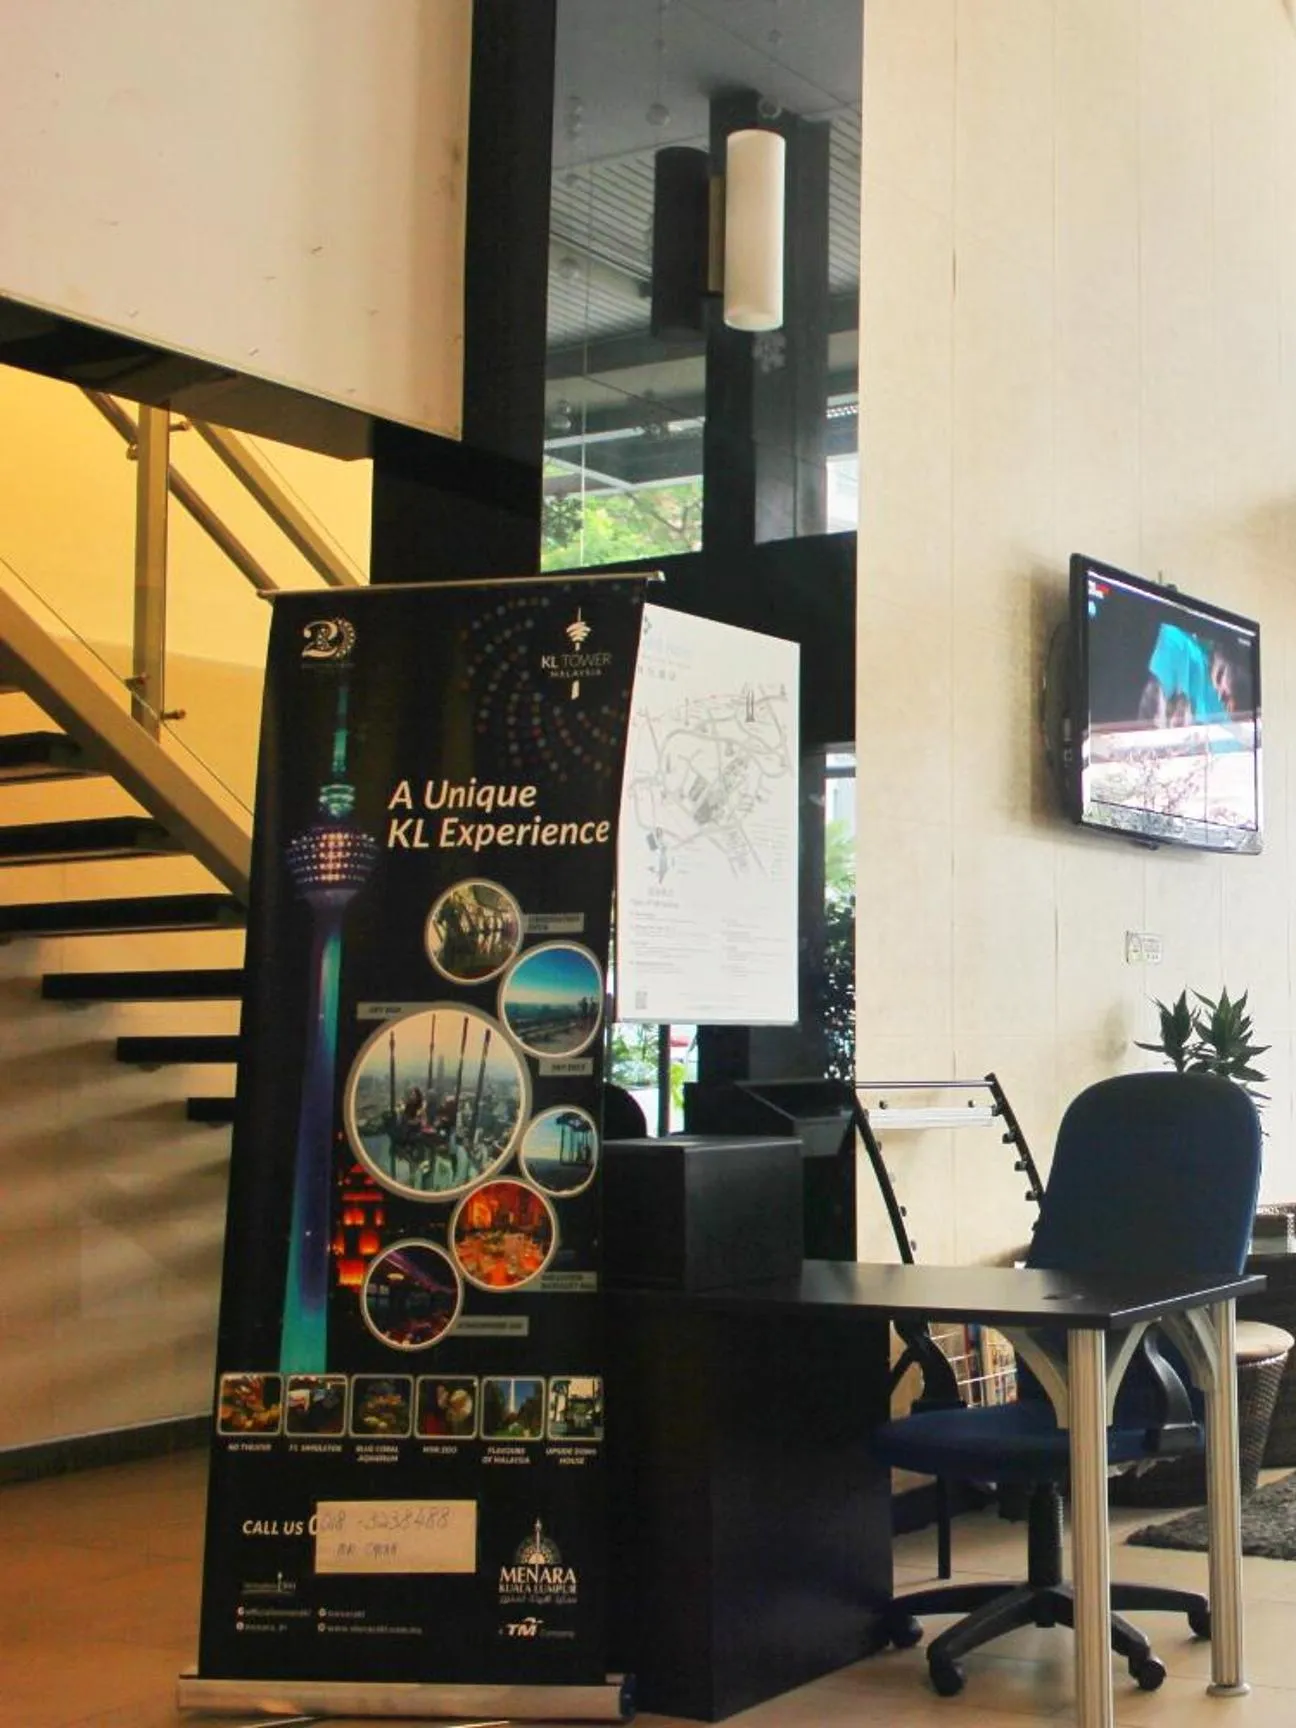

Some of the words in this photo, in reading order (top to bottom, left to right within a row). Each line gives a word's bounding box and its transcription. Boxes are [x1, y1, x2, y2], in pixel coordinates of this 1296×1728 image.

[541, 655, 559, 669] KL
[561, 652, 613, 668] TOWER
[388, 780, 413, 810] A
[423, 777, 537, 813] Unique
[387, 818, 430, 848] KL
[438, 815, 611, 852] Experience
[242, 1520, 280, 1536] CALL
[282, 1520, 304, 1536] US
[499, 1566, 577, 1584] MENARA
[498, 1583, 531, 1594] KUALA
[533, 1583, 577, 1594] LUMPUR
[505, 1621, 539, 1637] TM
